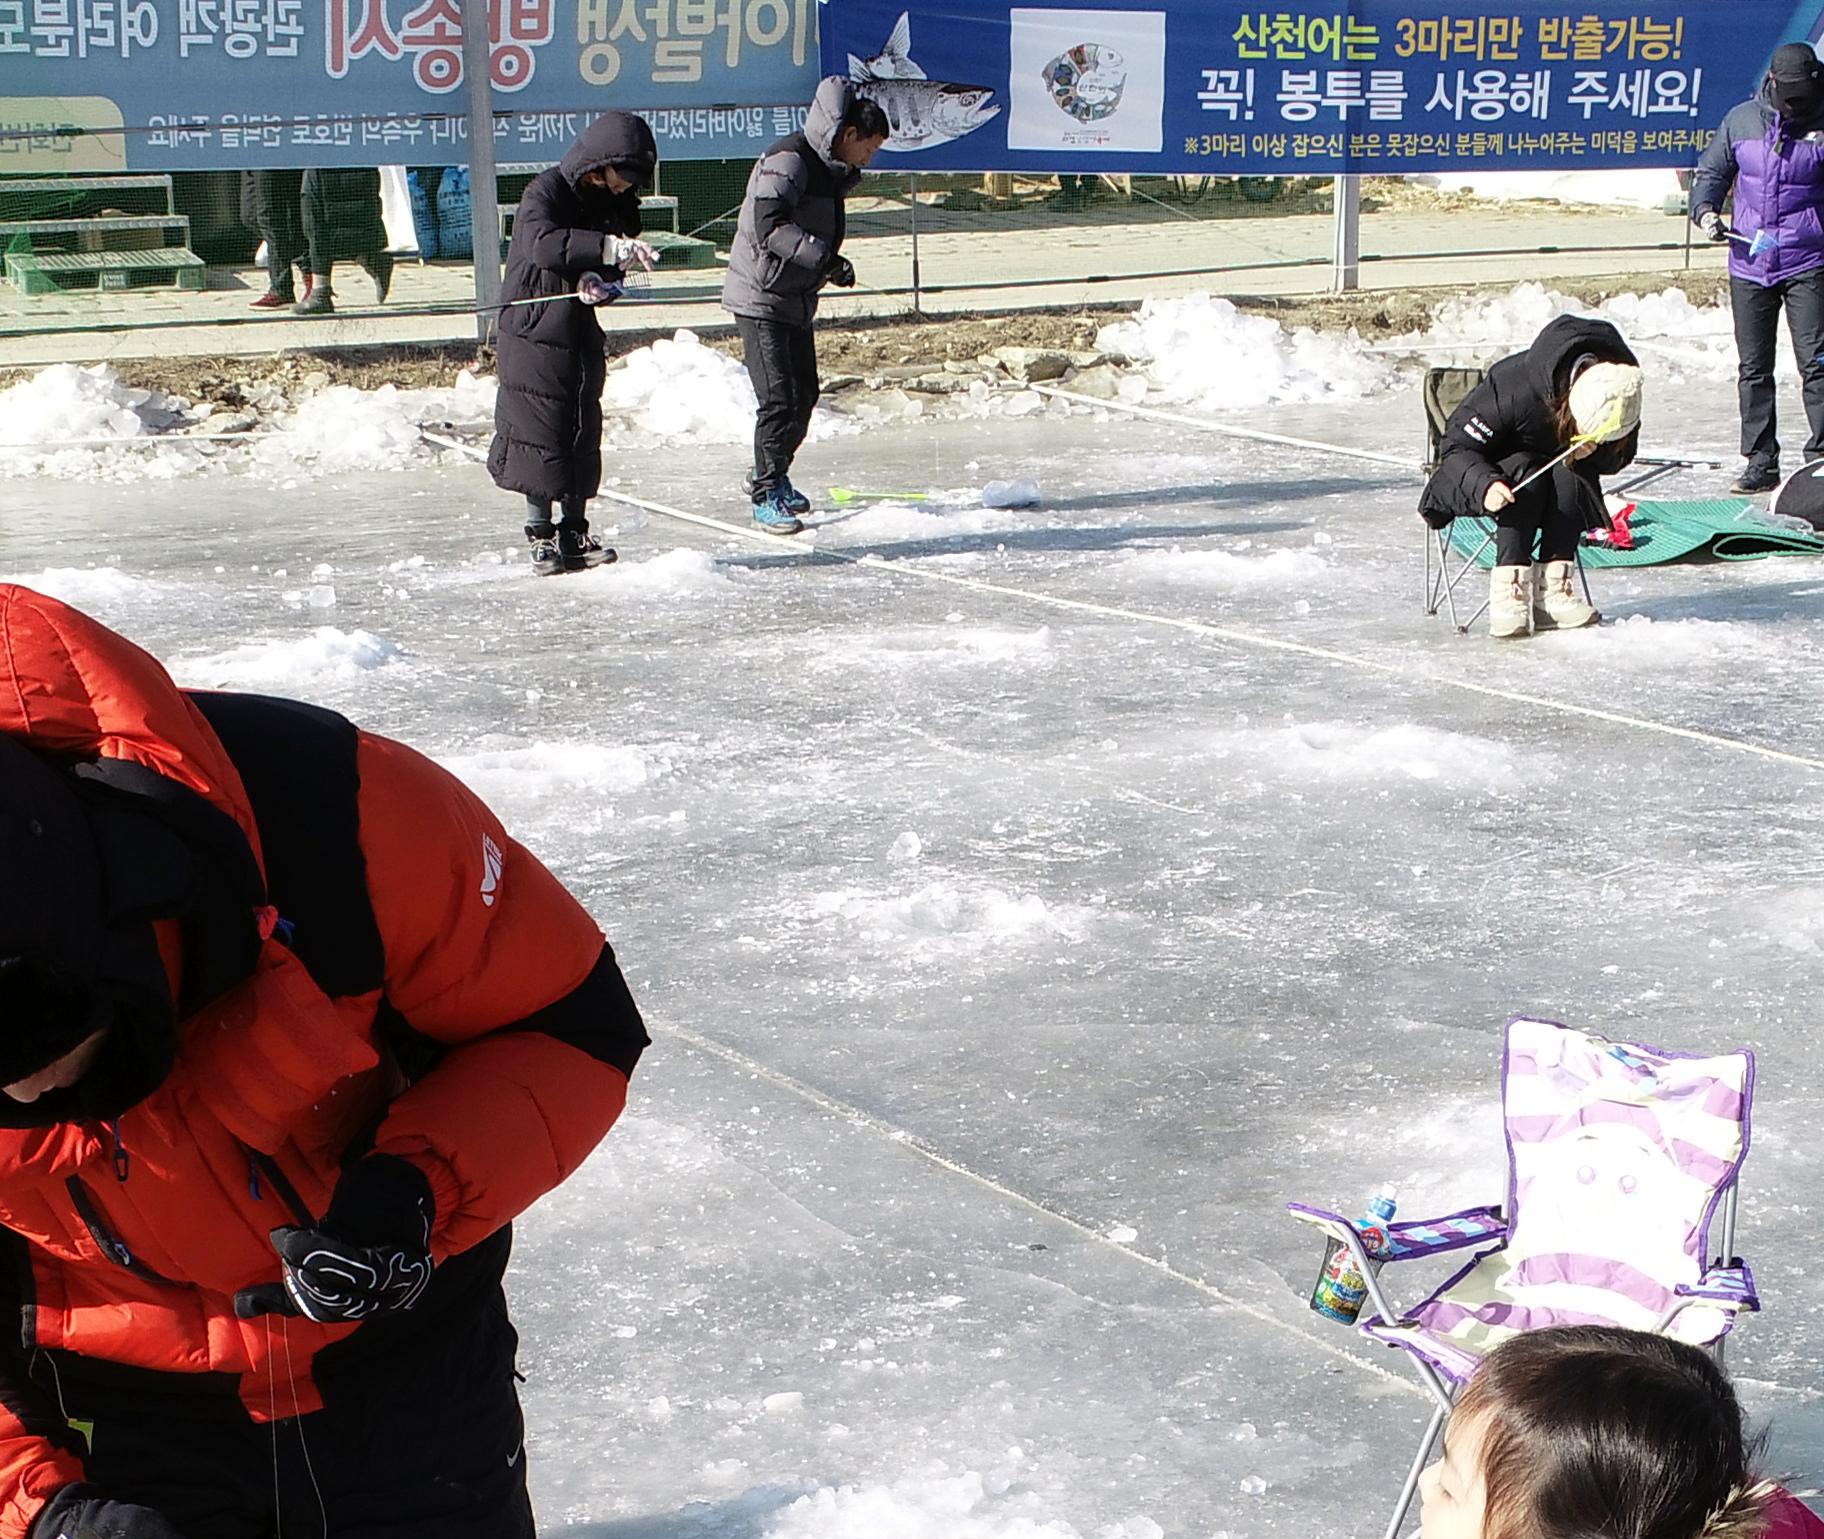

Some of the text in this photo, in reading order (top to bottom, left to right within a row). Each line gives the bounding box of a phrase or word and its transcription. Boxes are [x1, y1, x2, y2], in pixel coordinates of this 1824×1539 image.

[1232, 14, 1684, 61] 산천어는 3마리만 반출가능!
[1197, 68, 1702, 121] 꼭! 봉투를 사용해 주세요!
[1252, 133, 1287, 158] 이상
[1291, 133, 1344, 159] 잡으신
[1349, 133, 1381, 158] 분은
[1386, 132, 1451, 158] 못잡으신
[1455, 132, 1503, 157] 분들께
[1508, 131, 1586, 157] 나누어주는
[1591, 130, 1638, 155] 미덕을
